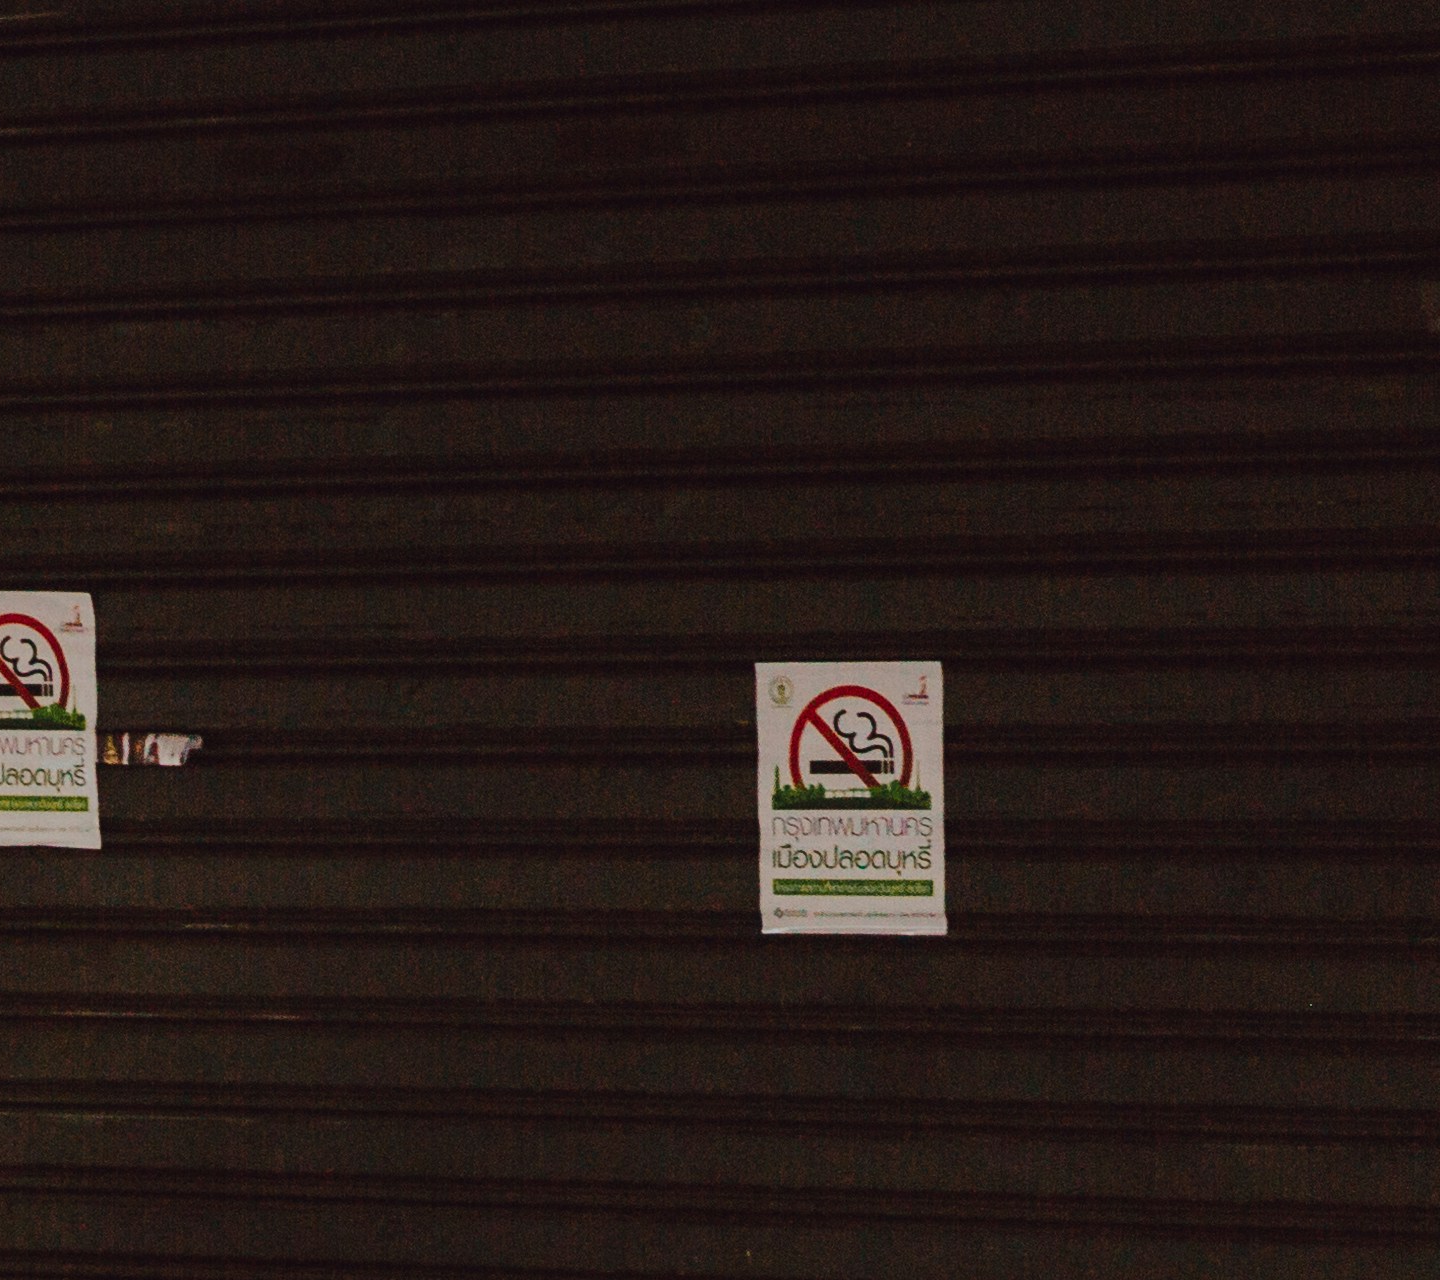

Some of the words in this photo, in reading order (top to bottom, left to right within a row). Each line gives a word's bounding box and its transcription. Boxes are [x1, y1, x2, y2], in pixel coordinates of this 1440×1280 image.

[772, 815, 933, 843] กรุงเทพมหานคร
[772, 842, 932, 876] เมืองปลอดบุหรี่
